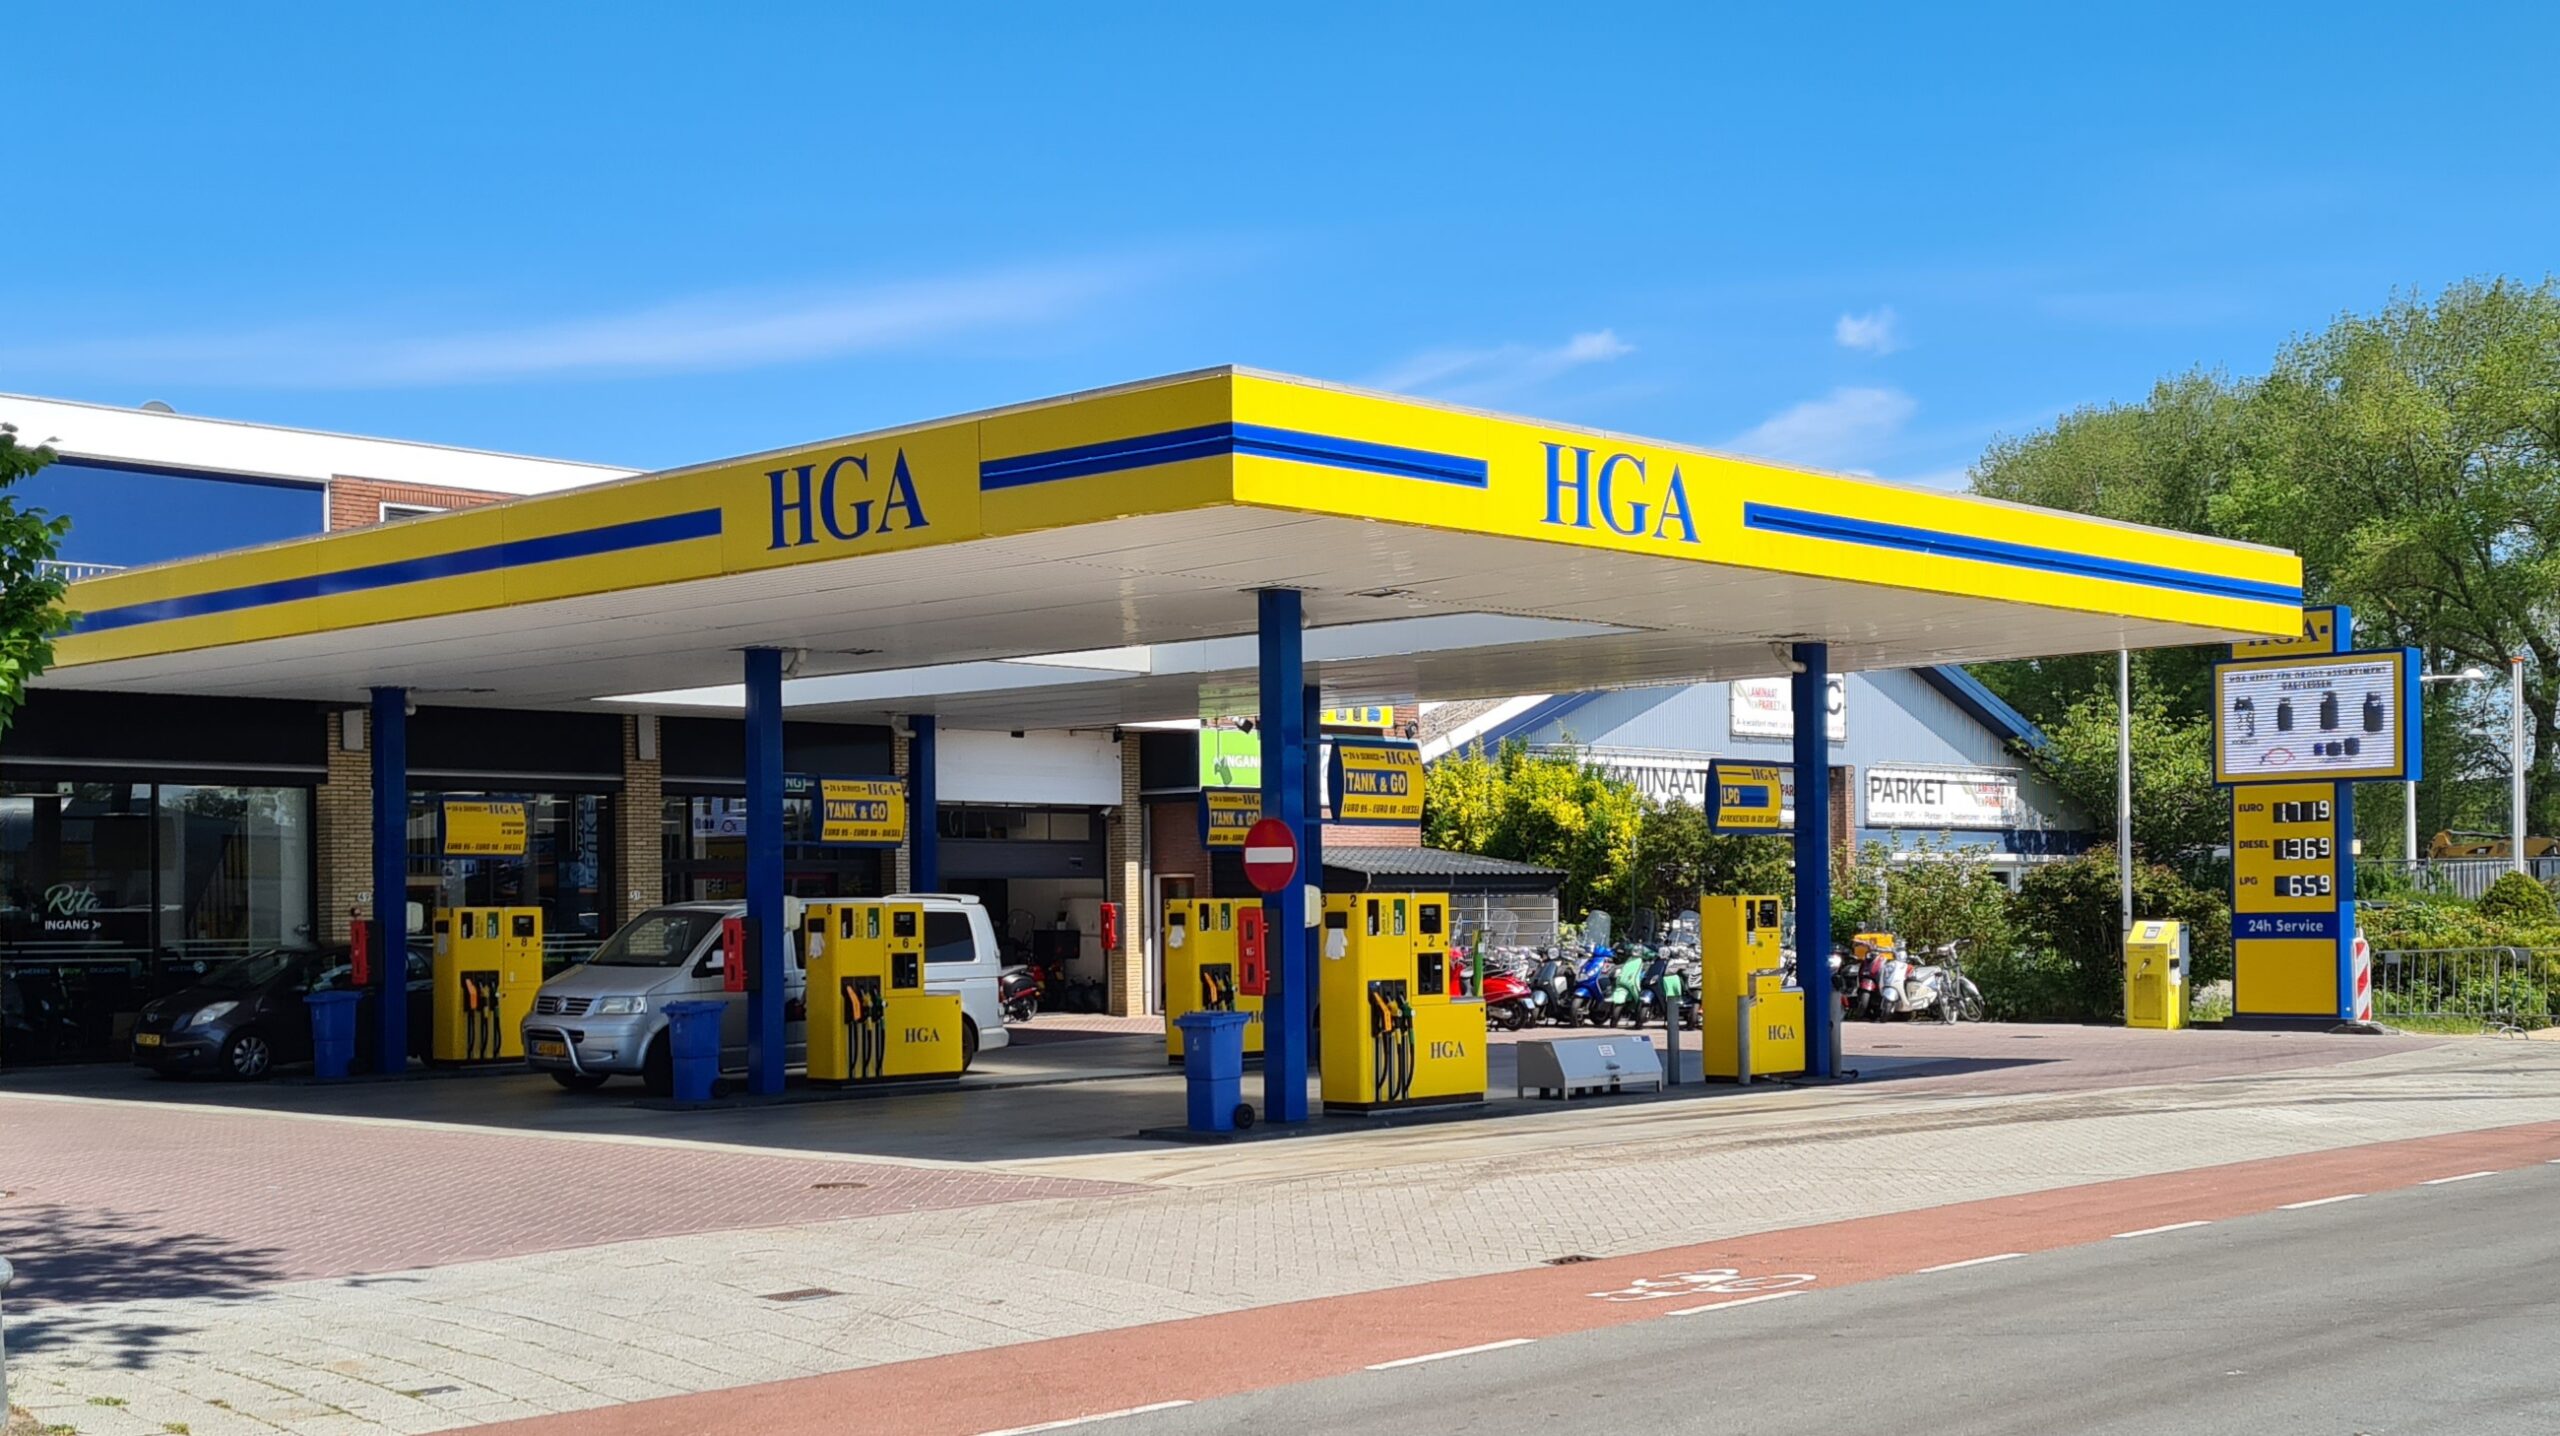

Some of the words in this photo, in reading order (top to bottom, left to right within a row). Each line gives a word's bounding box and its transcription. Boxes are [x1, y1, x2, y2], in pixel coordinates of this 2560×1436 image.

[764, 447, 930, 550] HGA
[1539, 441, 1702, 543] HGA
[1225, 755, 1261, 768] INGAN
[1386, 751, 1415, 766] HGA
[1751, 768, 1775, 780] HGA
[868, 783, 896, 795] HGA
[1347, 772, 1377, 792] TANK
[1380, 777, 1387, 792] &
[1390, 774, 1406, 793] GO
[1723, 787, 1740, 804] LPG
[1870, 776, 1947, 805] PARKET
[1243, 795, 1260, 805] HG
[489, 804, 517, 814] HGA
[827, 801, 857, 819] TANK
[860, 805, 868, 819] &
[870, 802, 886, 820] GO
[2239, 804, 2264, 812] EURO
[1212, 811, 1235, 825] TANK
[2239, 840, 2269, 849] DIESEL
[2239, 877, 2258, 885] LPG
[45, 883, 100, 915] Rita
[1350, 895, 1357, 908] 2
[45, 920, 89, 930] INGANG
[2248, 920, 2272, 932] 24h
[2276, 919, 2324, 932] Service
[521, 937, 527, 947] 8
[902, 937, 909, 949] 6
[1428, 935, 1435, 947] 2
[905, 1027, 940, 1043] HGA
[1768, 1025, 1795, 1040] HGA
[1430, 1041, 1465, 1059] HGA
